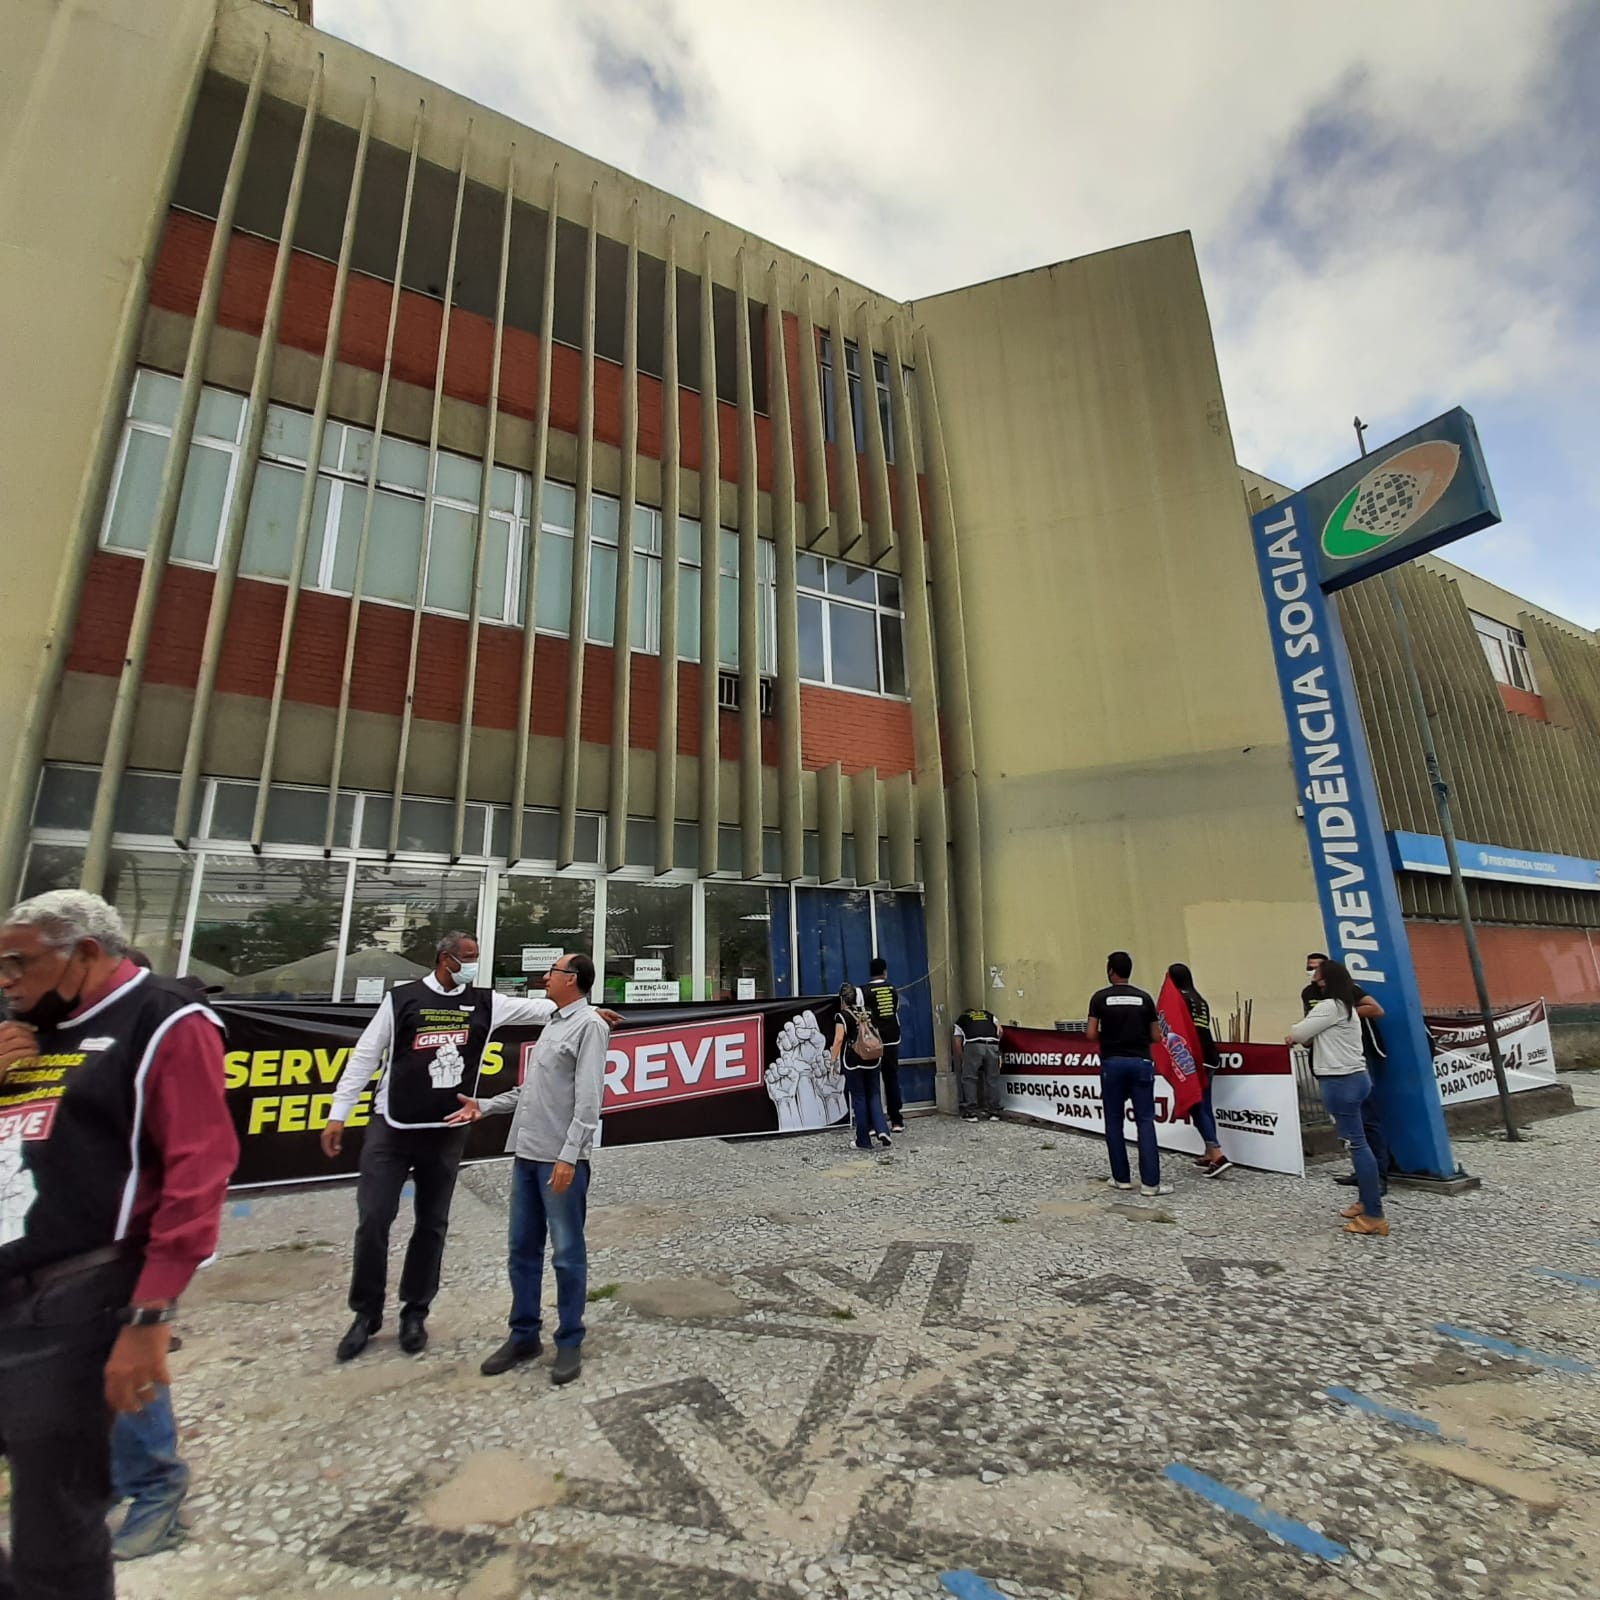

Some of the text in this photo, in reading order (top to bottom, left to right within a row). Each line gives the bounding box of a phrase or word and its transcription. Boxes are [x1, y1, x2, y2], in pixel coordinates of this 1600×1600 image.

[1264, 505, 1386, 984] PREVIDÊNCIA SOCIAL
[634, 984, 669, 992] ATENÇÃO!
[418, 1033, 465, 1046] GREVE
[603, 1032, 746, 1096] REVE
[1003, 1053, 1062, 1066] ERVIDORES
[1063, 1053, 1081, 1066] 05
[1006, 1080, 1070, 1101] REPOSIÇÃO
[1440, 1080, 1468, 1098] PARA
[1056, 1102, 1093, 1119] PARA
